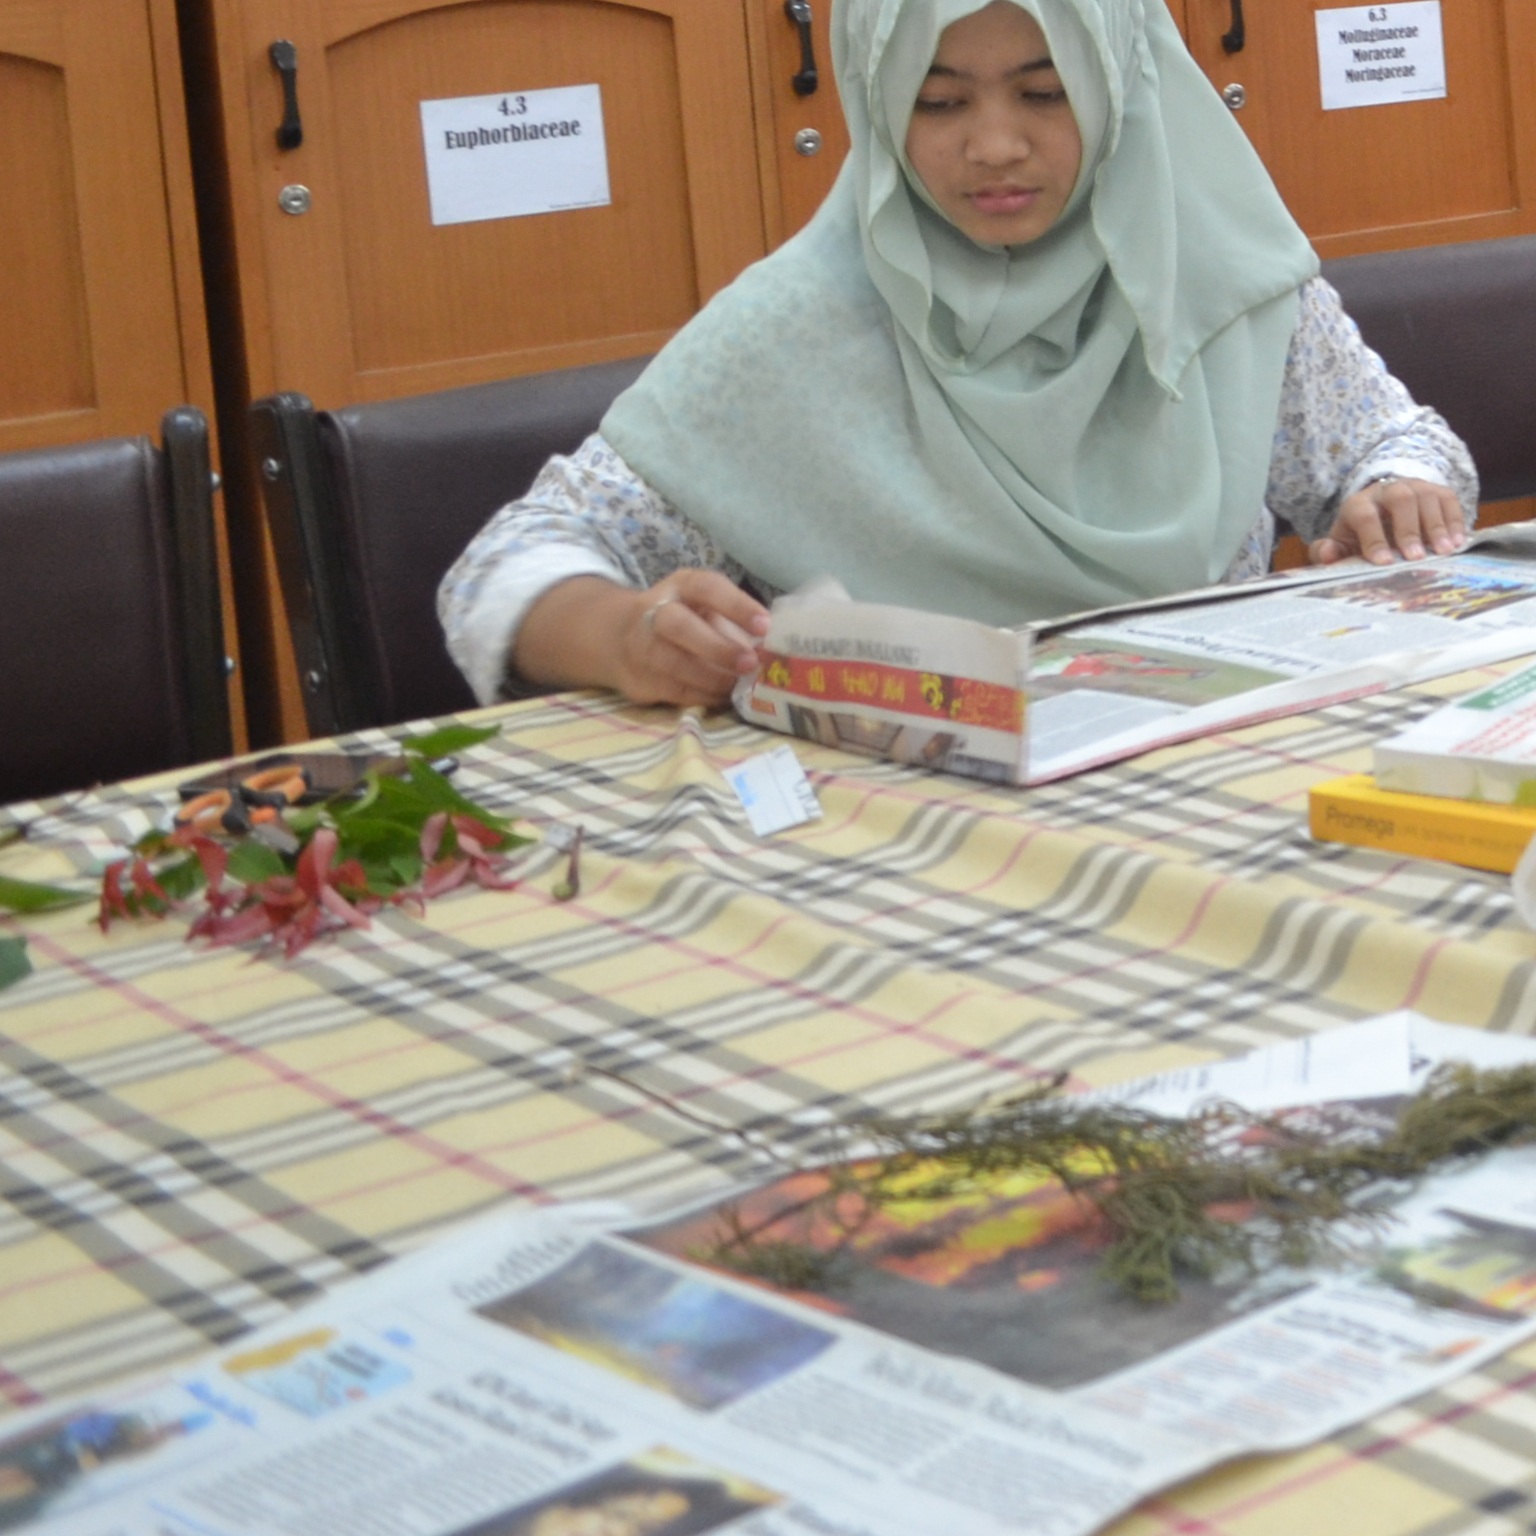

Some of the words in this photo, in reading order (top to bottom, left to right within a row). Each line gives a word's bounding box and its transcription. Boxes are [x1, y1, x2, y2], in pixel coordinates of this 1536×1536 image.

[1368, 8, 1387, 22] 6.3
[1352, 47, 1405, 62] Moraceae
[1345, 64, 1416, 84] Moringaceae
[497, 96, 528, 116] 4.3
[445, 118, 581, 150] Euphorbiaceae
